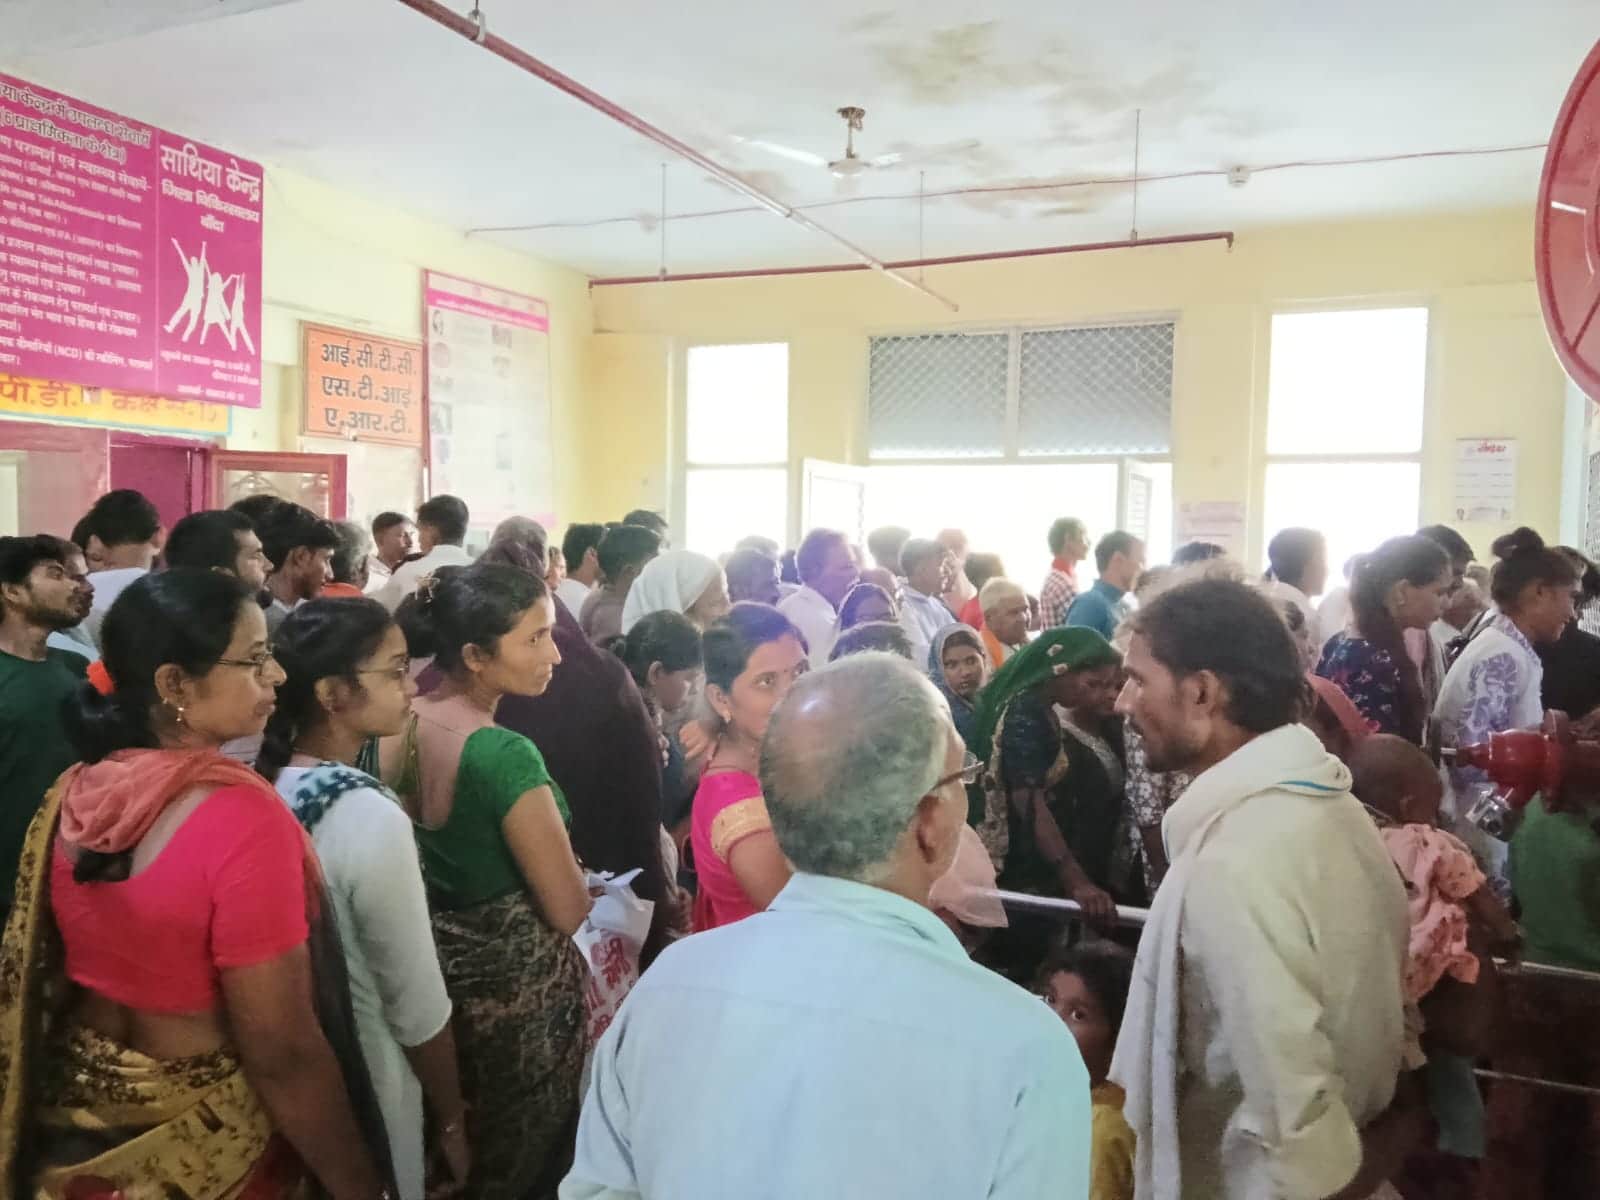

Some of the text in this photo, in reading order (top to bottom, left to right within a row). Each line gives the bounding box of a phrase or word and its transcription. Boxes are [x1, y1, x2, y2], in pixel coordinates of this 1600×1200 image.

[54, 98, 68, 119] में
[160, 142, 223, 187] साथिया
[225, 158, 260, 202] केन्द्र
